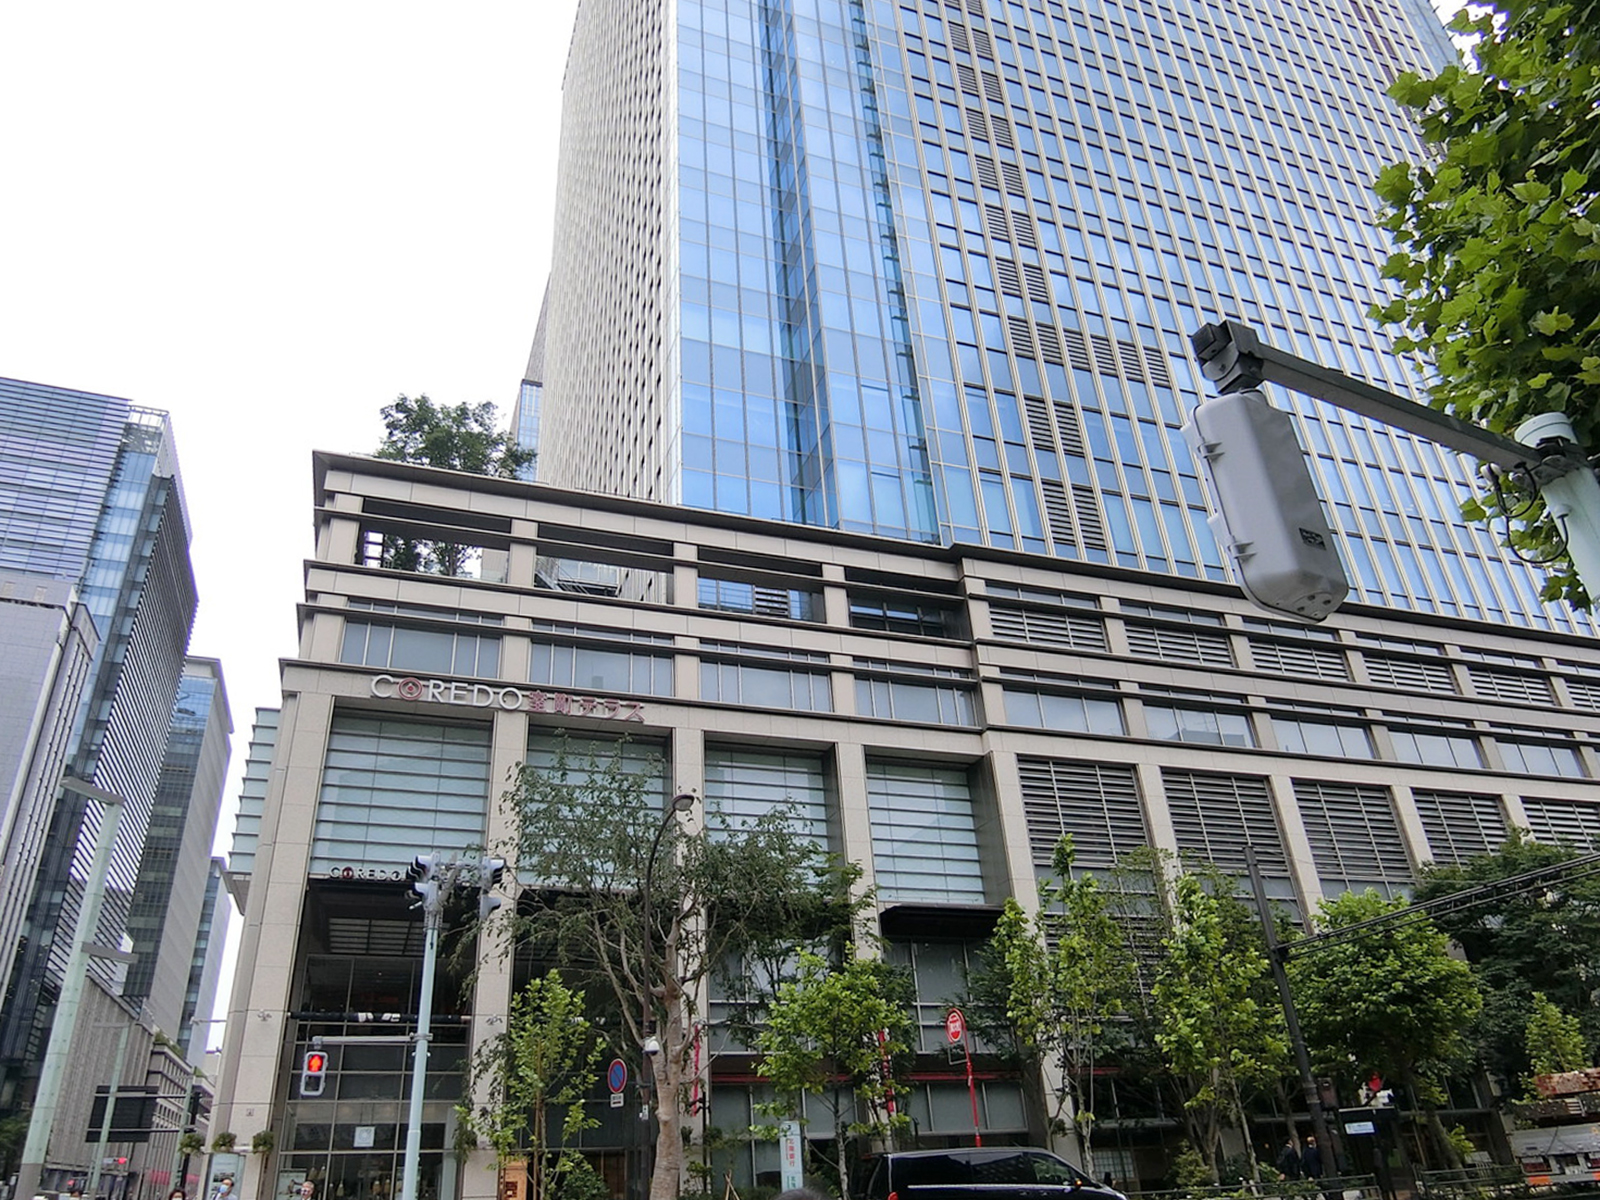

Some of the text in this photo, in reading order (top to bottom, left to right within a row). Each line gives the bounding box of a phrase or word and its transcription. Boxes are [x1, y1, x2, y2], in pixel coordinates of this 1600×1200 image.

[371, 674, 646, 723] COREDO 室町テラス
[330, 866, 401, 881] COREDO
